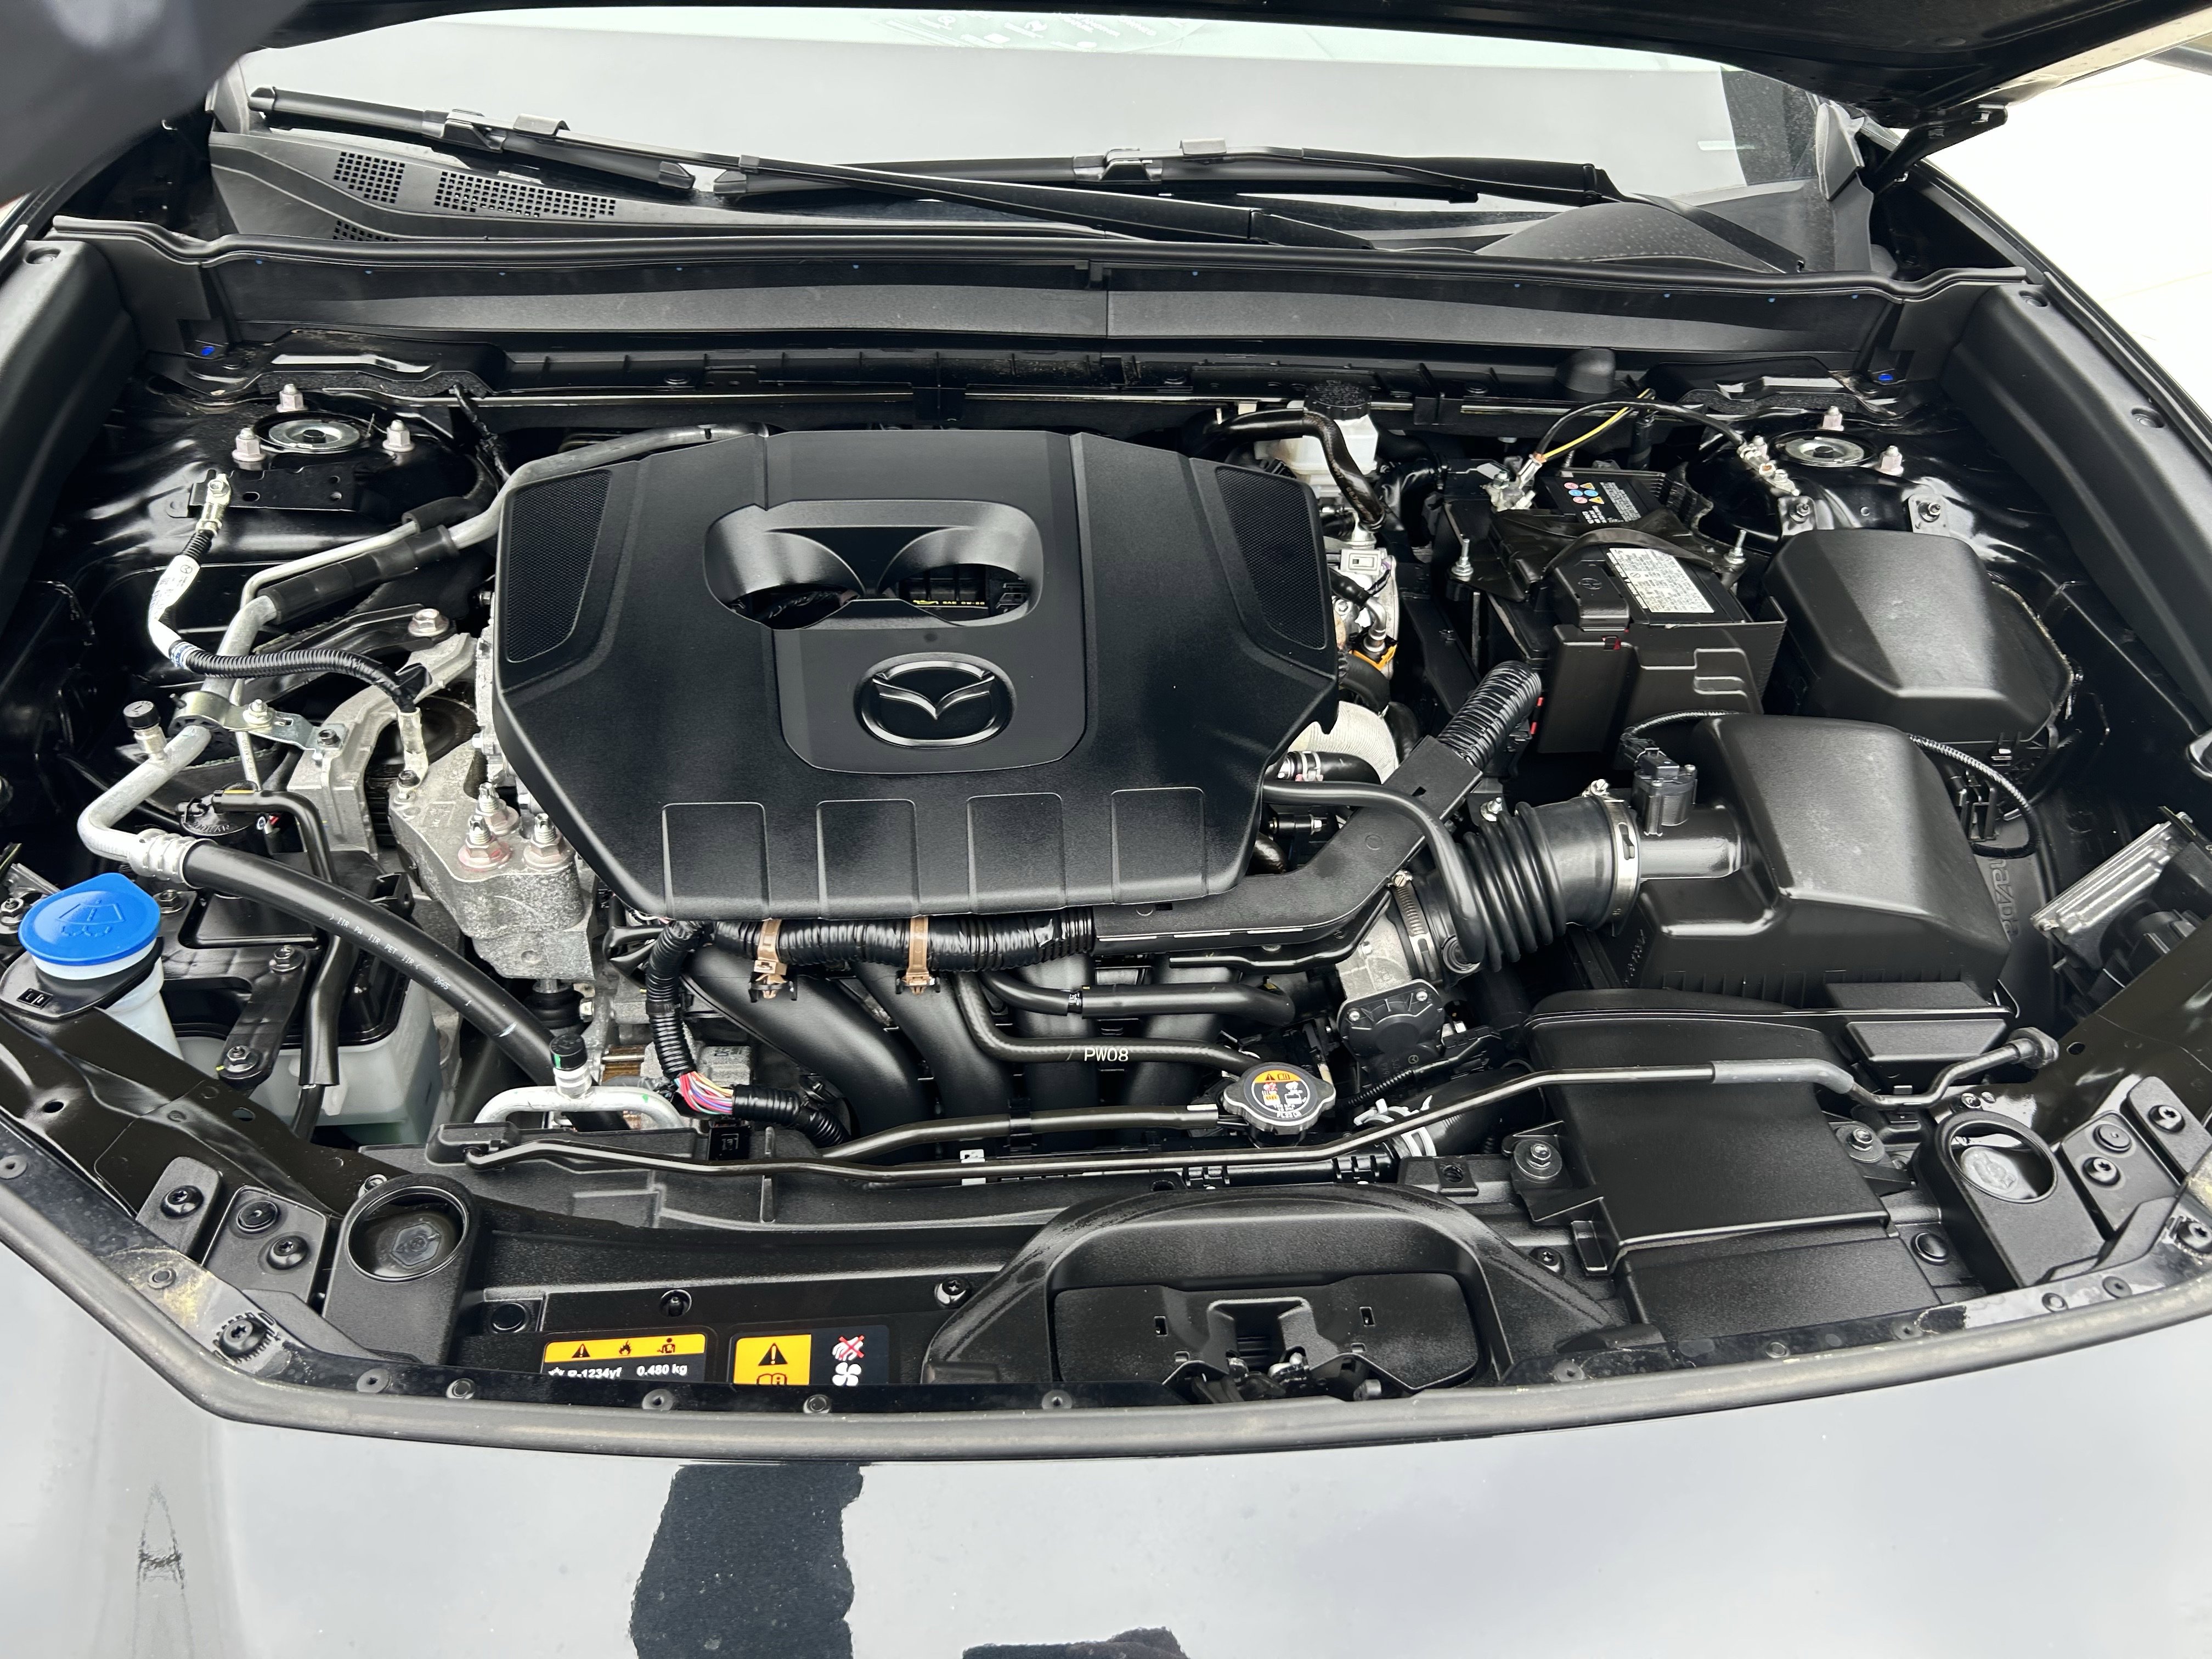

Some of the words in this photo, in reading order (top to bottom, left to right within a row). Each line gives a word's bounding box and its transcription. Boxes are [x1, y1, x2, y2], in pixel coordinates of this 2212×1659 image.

[383, 943, 398, 955] PET
[1084, 1047, 1129, 1062] PW08
[636, 1364, 670, 1376] 0.480
[672, 1363, 688, 1376] kg
